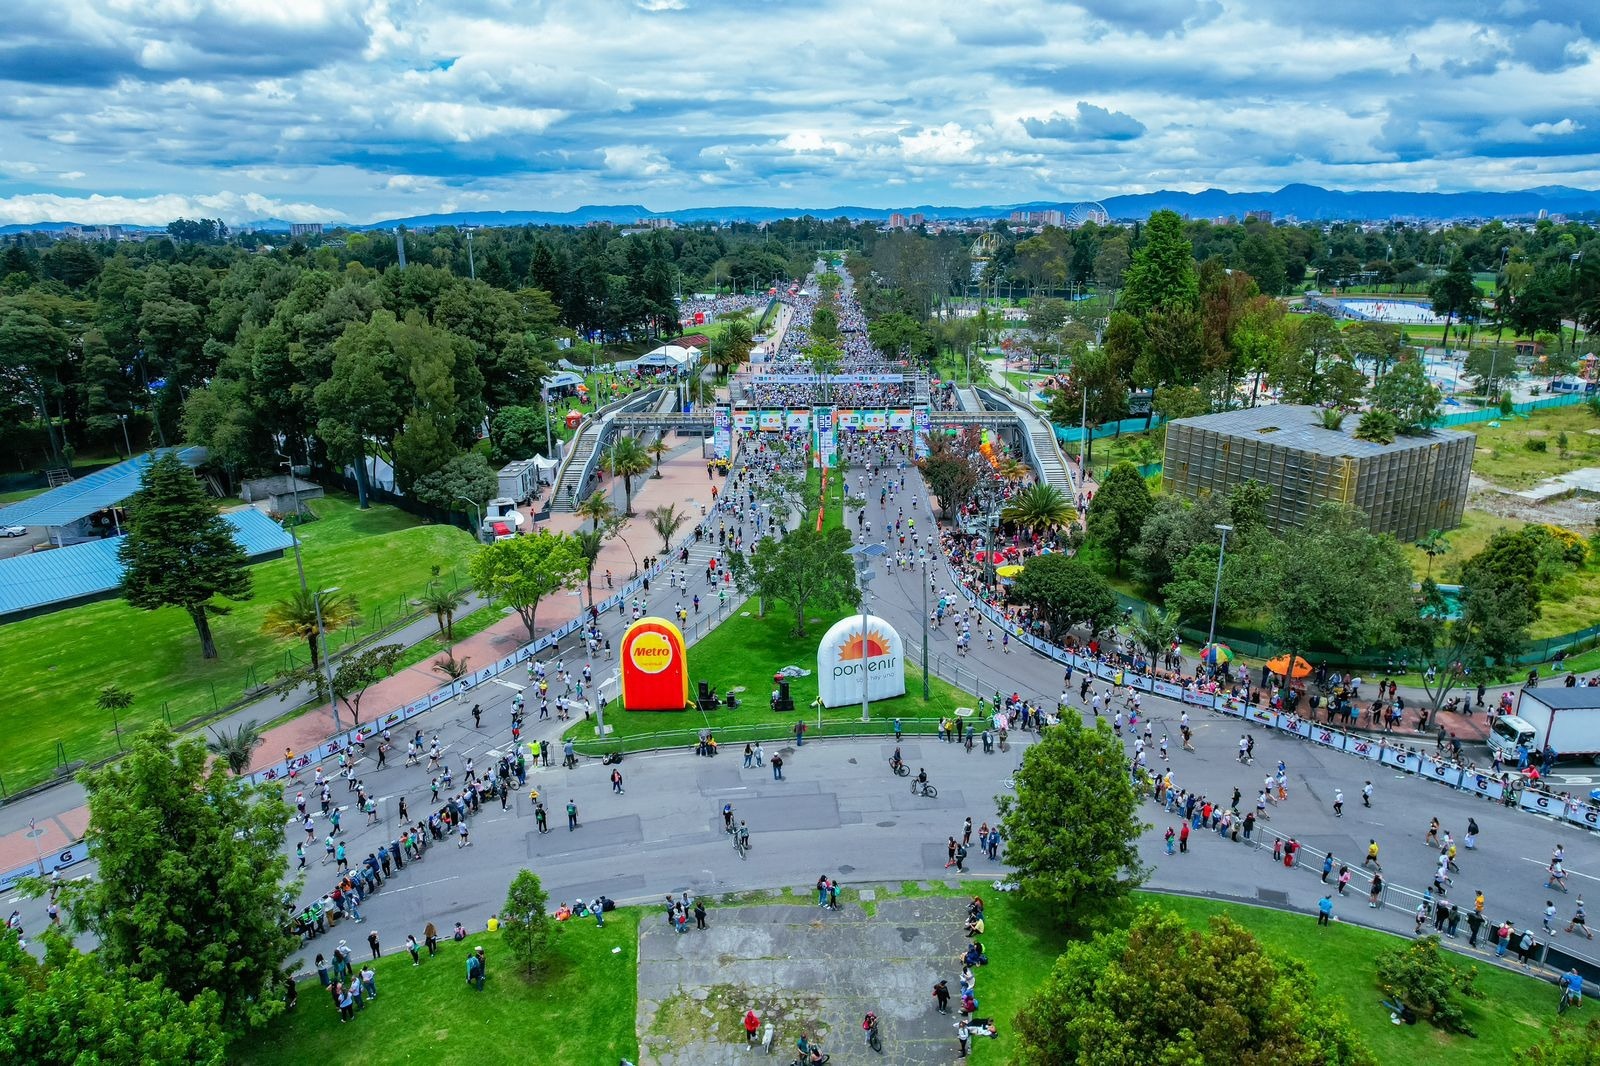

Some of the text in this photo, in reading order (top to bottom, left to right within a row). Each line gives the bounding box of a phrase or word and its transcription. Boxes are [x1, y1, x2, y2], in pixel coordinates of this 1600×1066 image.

[633, 647, 670, 657] Metro
[833, 657, 896, 681] porvenir
[1396, 754, 1406, 764] G
[1435, 766, 1445, 776] G
[1477, 780, 1488, 790] G
[1537, 797, 1549, 807] G
[1585, 812, 1598, 823] G
[60, 850, 73, 862] G
